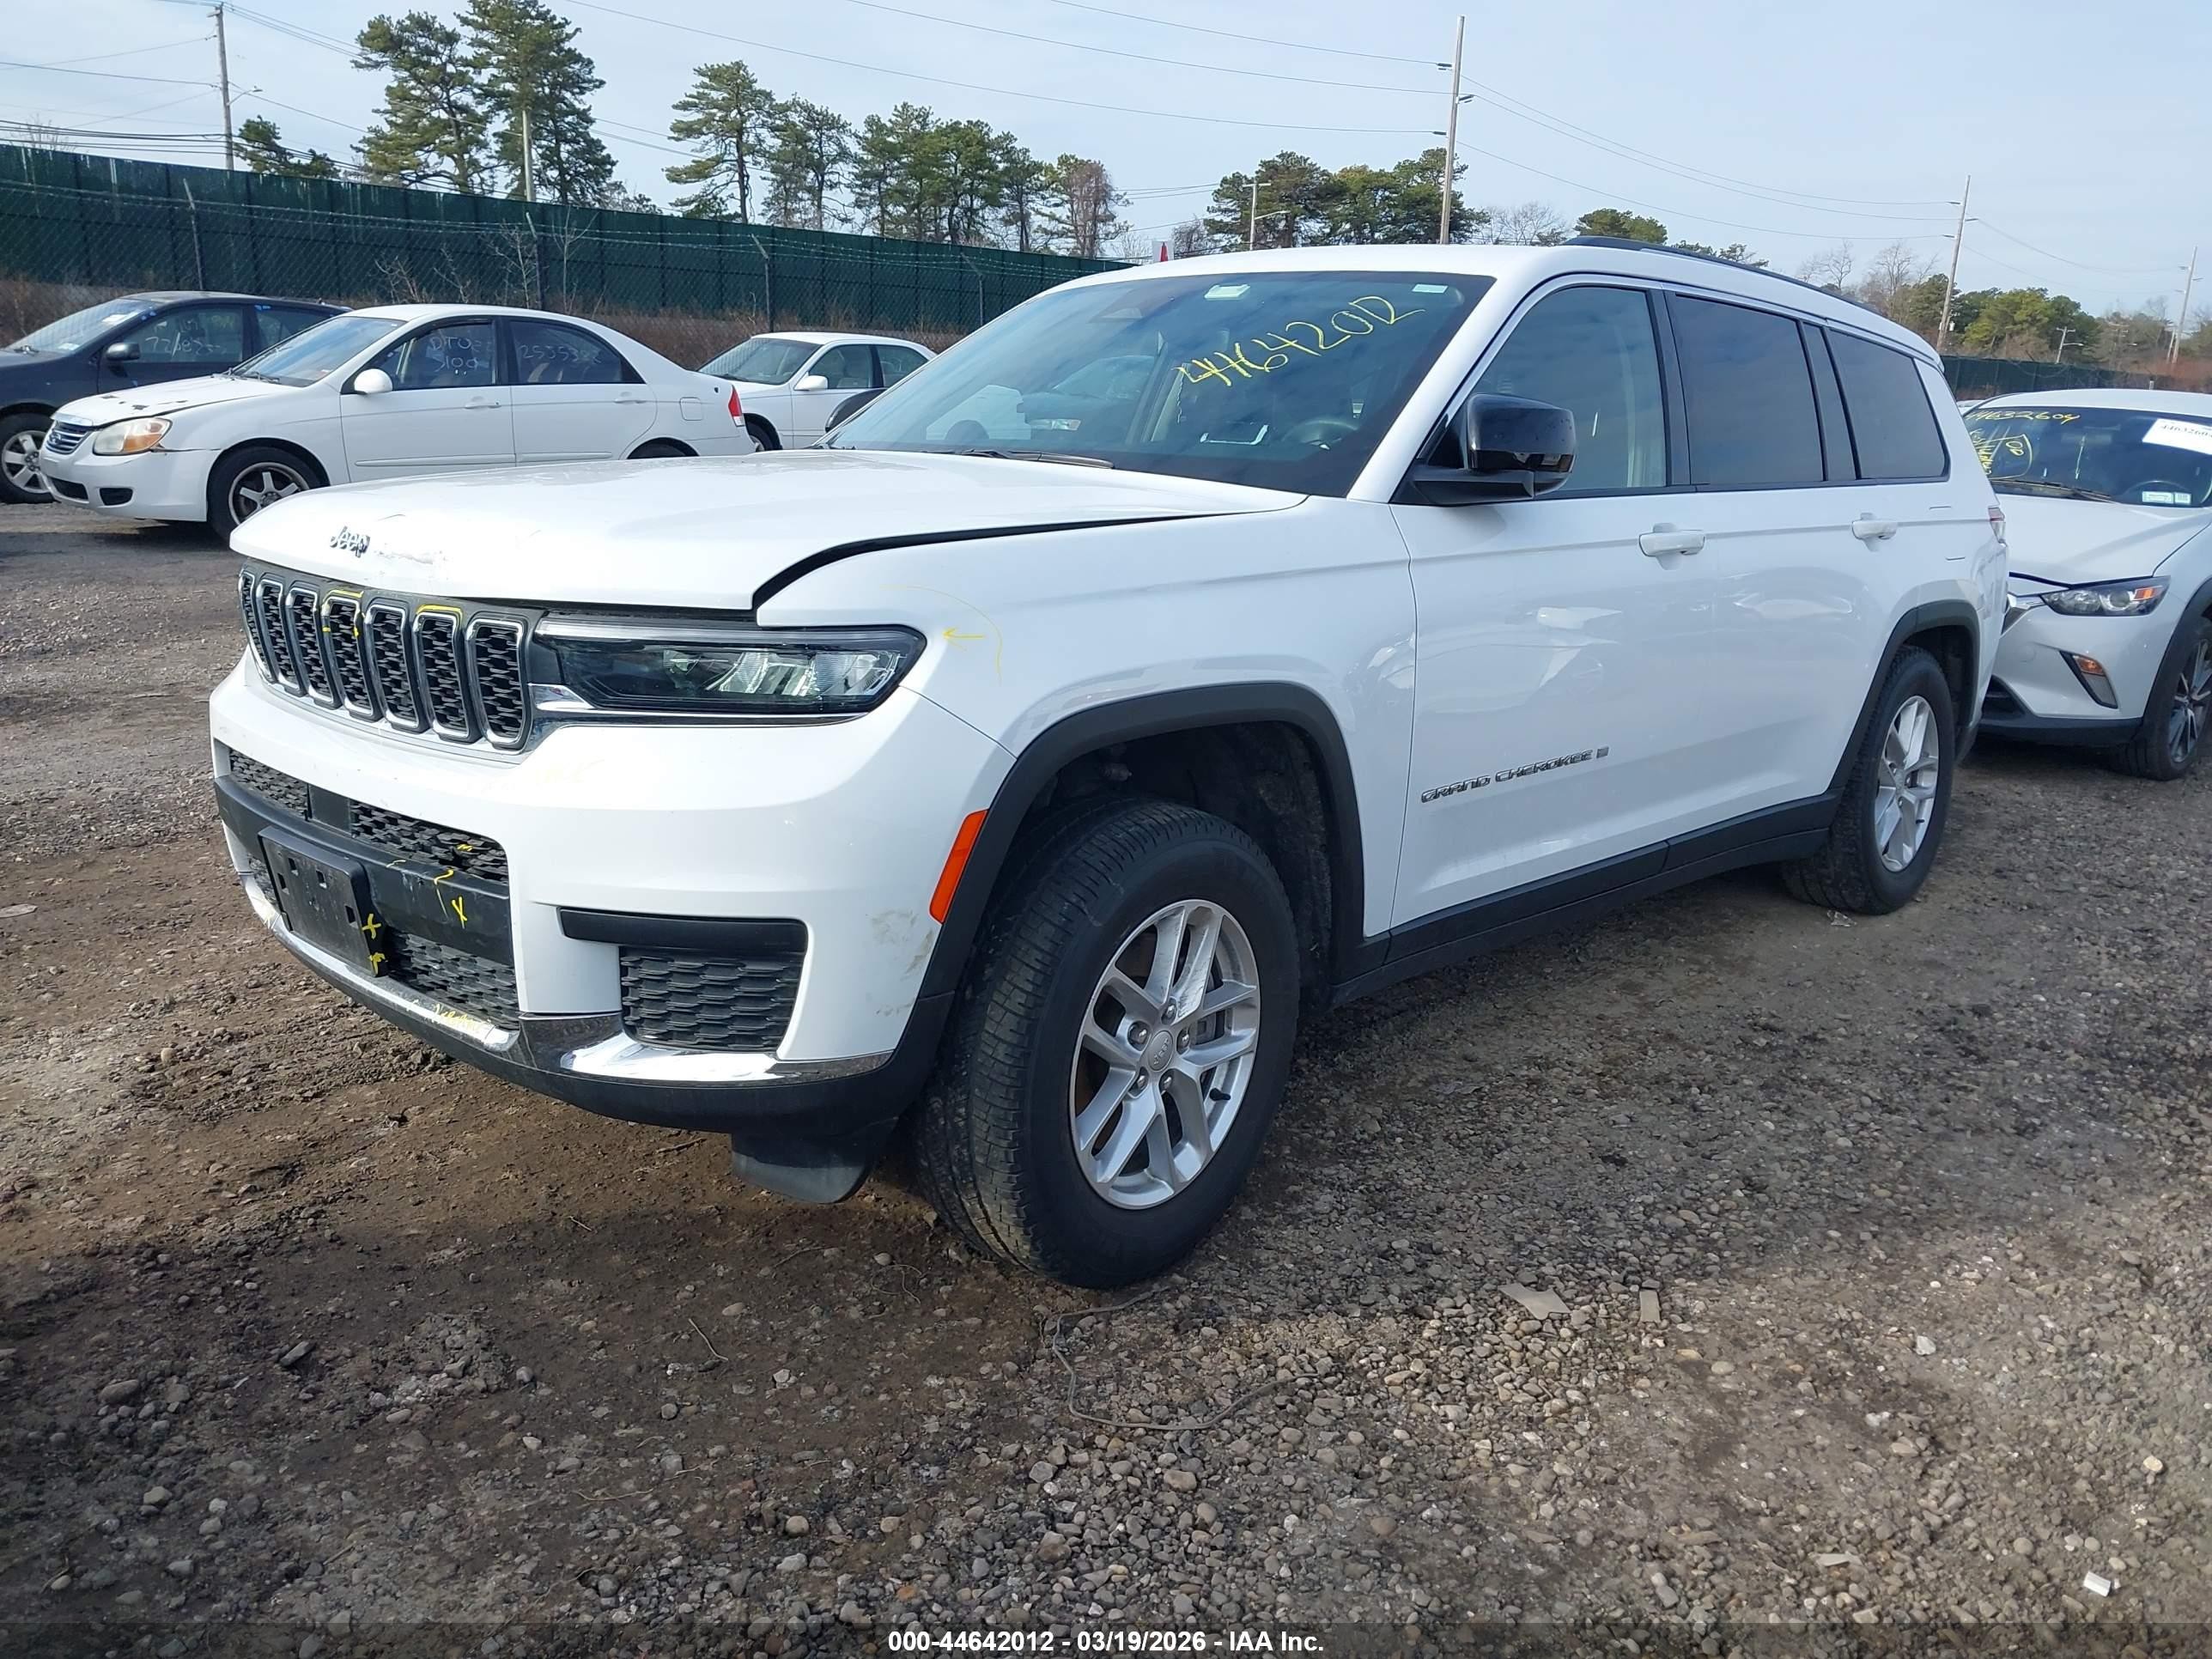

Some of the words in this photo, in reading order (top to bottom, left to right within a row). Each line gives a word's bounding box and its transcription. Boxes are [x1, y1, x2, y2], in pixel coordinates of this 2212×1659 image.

[330, 526, 371, 558] Jeep
[1421, 775, 1491, 803] GRAND
[1495, 749, 1593, 782] CHEROKEE
